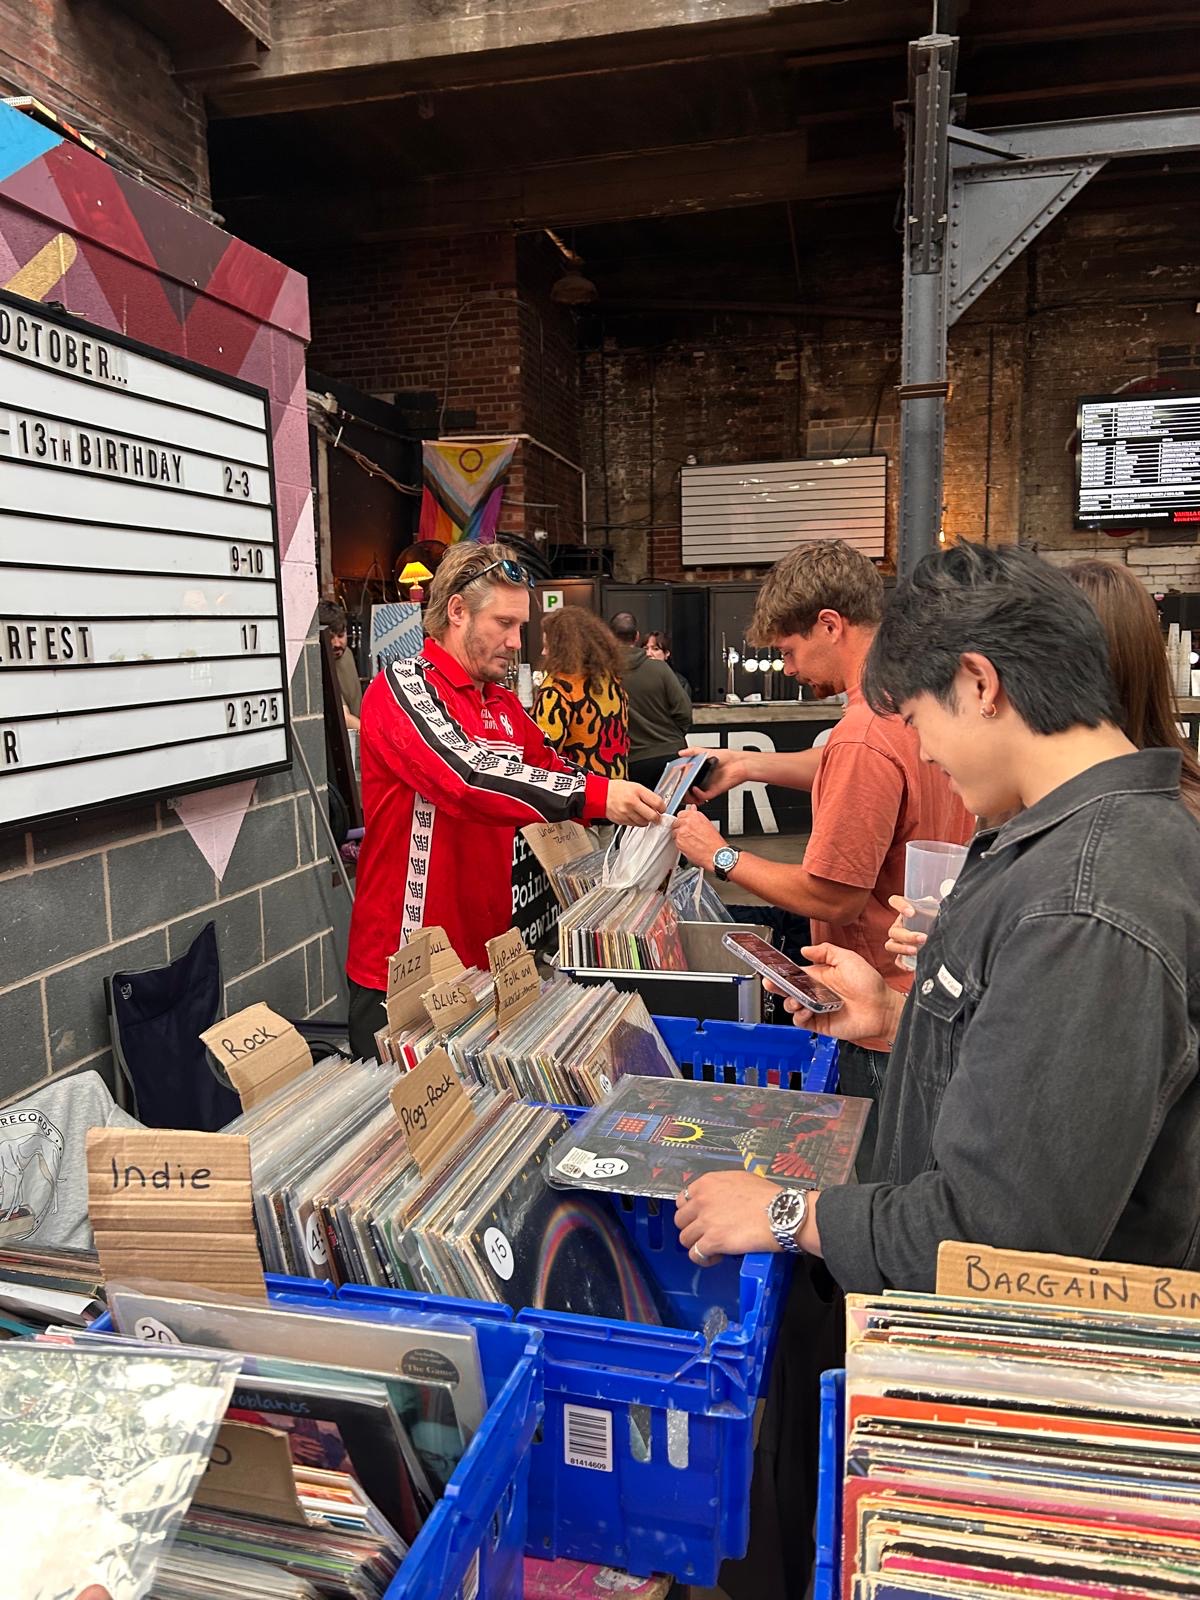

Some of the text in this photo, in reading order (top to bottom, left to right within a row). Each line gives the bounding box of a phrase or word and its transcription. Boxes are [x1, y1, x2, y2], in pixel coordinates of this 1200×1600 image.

[79, 433, 182, 483] BIRTHDAY
[224, 466, 250, 497] 2-3
[231, 546, 264, 573] 9-10
[547, 595, 558, 608] P
[0, 624, 258, 660] RFEST 17
[393, 955, 422, 984] JAZZ
[432, 987, 468, 1011] BLUES
[222, 1026, 278, 1061] Rock
[0, 1113, 53, 1136] RECORDS
[110, 1157, 212, 1190] Indie
[593, 1162, 616, 1176] 25
[491, 1238, 507, 1265] 15
[569, 1457, 607, 1471] 81414609
